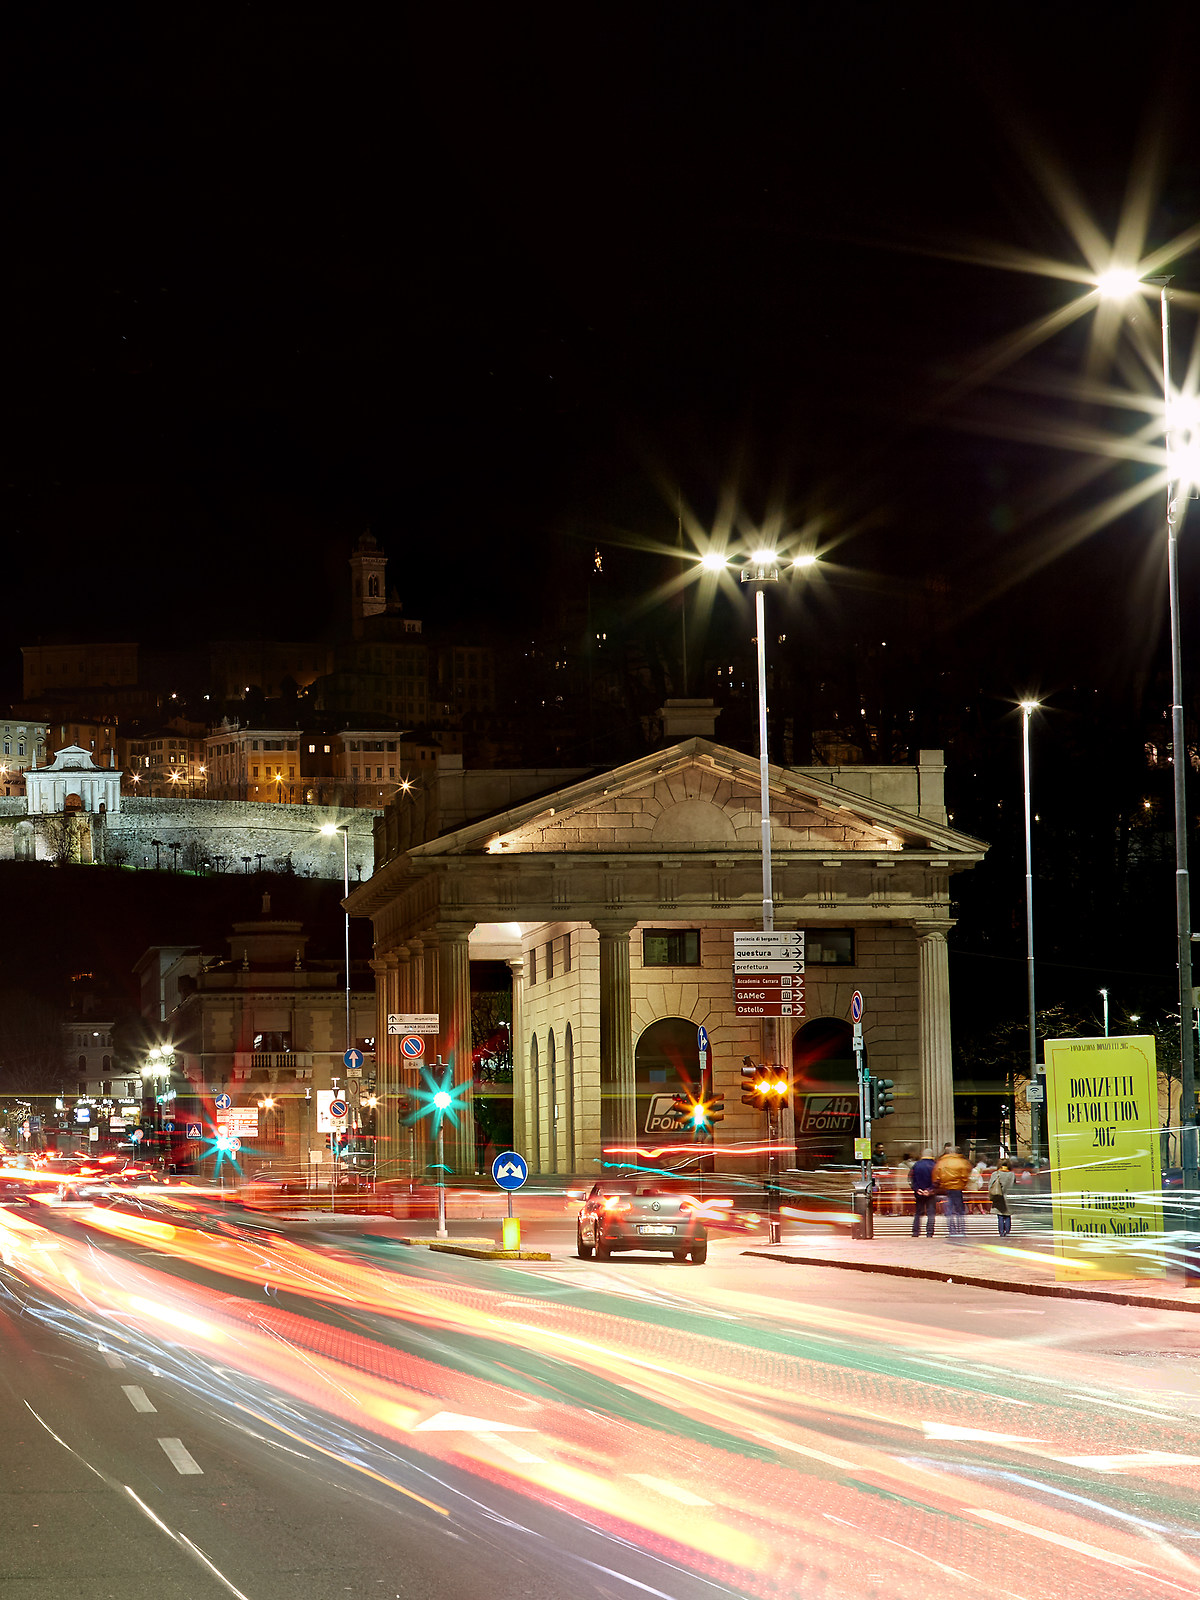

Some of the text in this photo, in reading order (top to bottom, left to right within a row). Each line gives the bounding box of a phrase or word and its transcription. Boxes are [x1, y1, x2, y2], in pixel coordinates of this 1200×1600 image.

[736, 950, 772, 958] questura
[1070, 1076, 1134, 1098] DONIZETTI
[1067, 1100, 1139, 1123] REVOLUTION
[806, 1116, 850, 1129] POINT
[1092, 1126, 1116, 1147] 2017
[1069, 1217, 1149, 1238] Teatro Sociale
